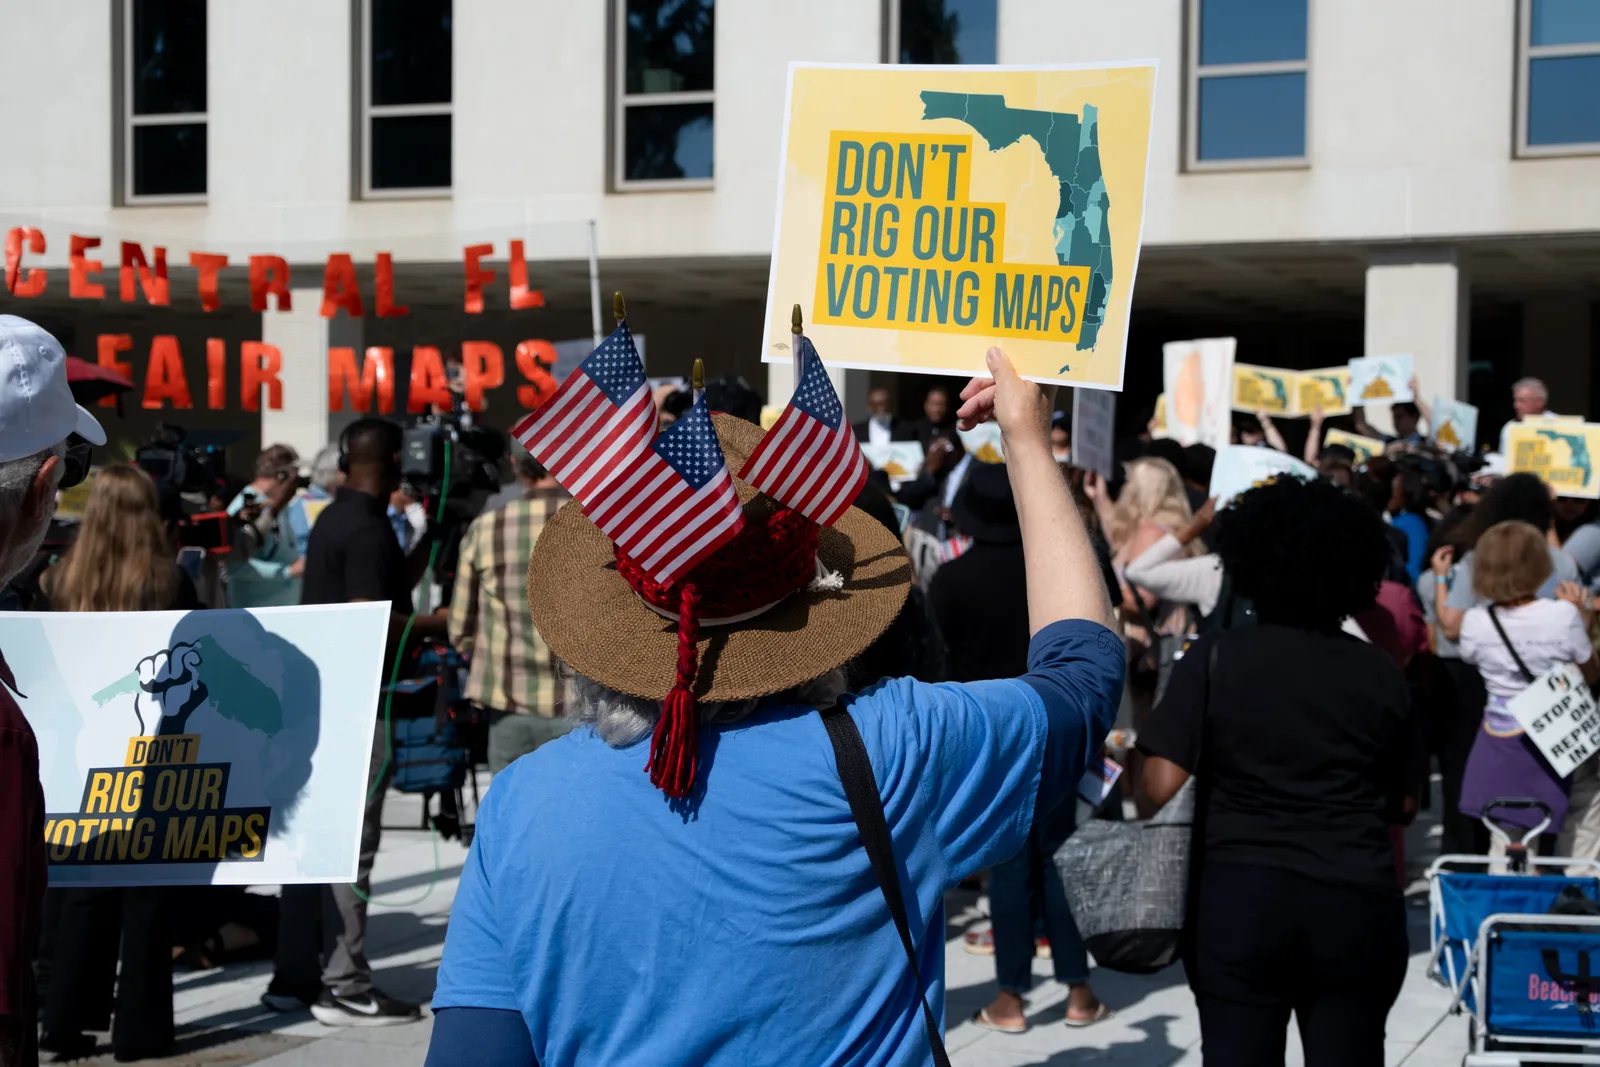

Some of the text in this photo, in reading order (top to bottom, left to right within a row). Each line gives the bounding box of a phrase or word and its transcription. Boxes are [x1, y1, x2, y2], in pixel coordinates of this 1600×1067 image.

[834, 140, 967, 202] DON'T
[829, 201, 996, 264] RIG OUR
[4, 226, 545, 317] CENTRAL FL
[826, 262, 1081, 334] VOTING MAPS
[97, 333, 558, 414] FAIR MAPS
[1531, 695, 1571, 734] STOP
[1570, 699, 1592, 722] ON
[132, 738, 194, 765] DON'T
[1551, 712, 1600, 758] REPRE
[1568, 744, 1589, 764] IN
[85, 767, 225, 814] RIG OUR
[162, 813, 266, 860] MAPS
